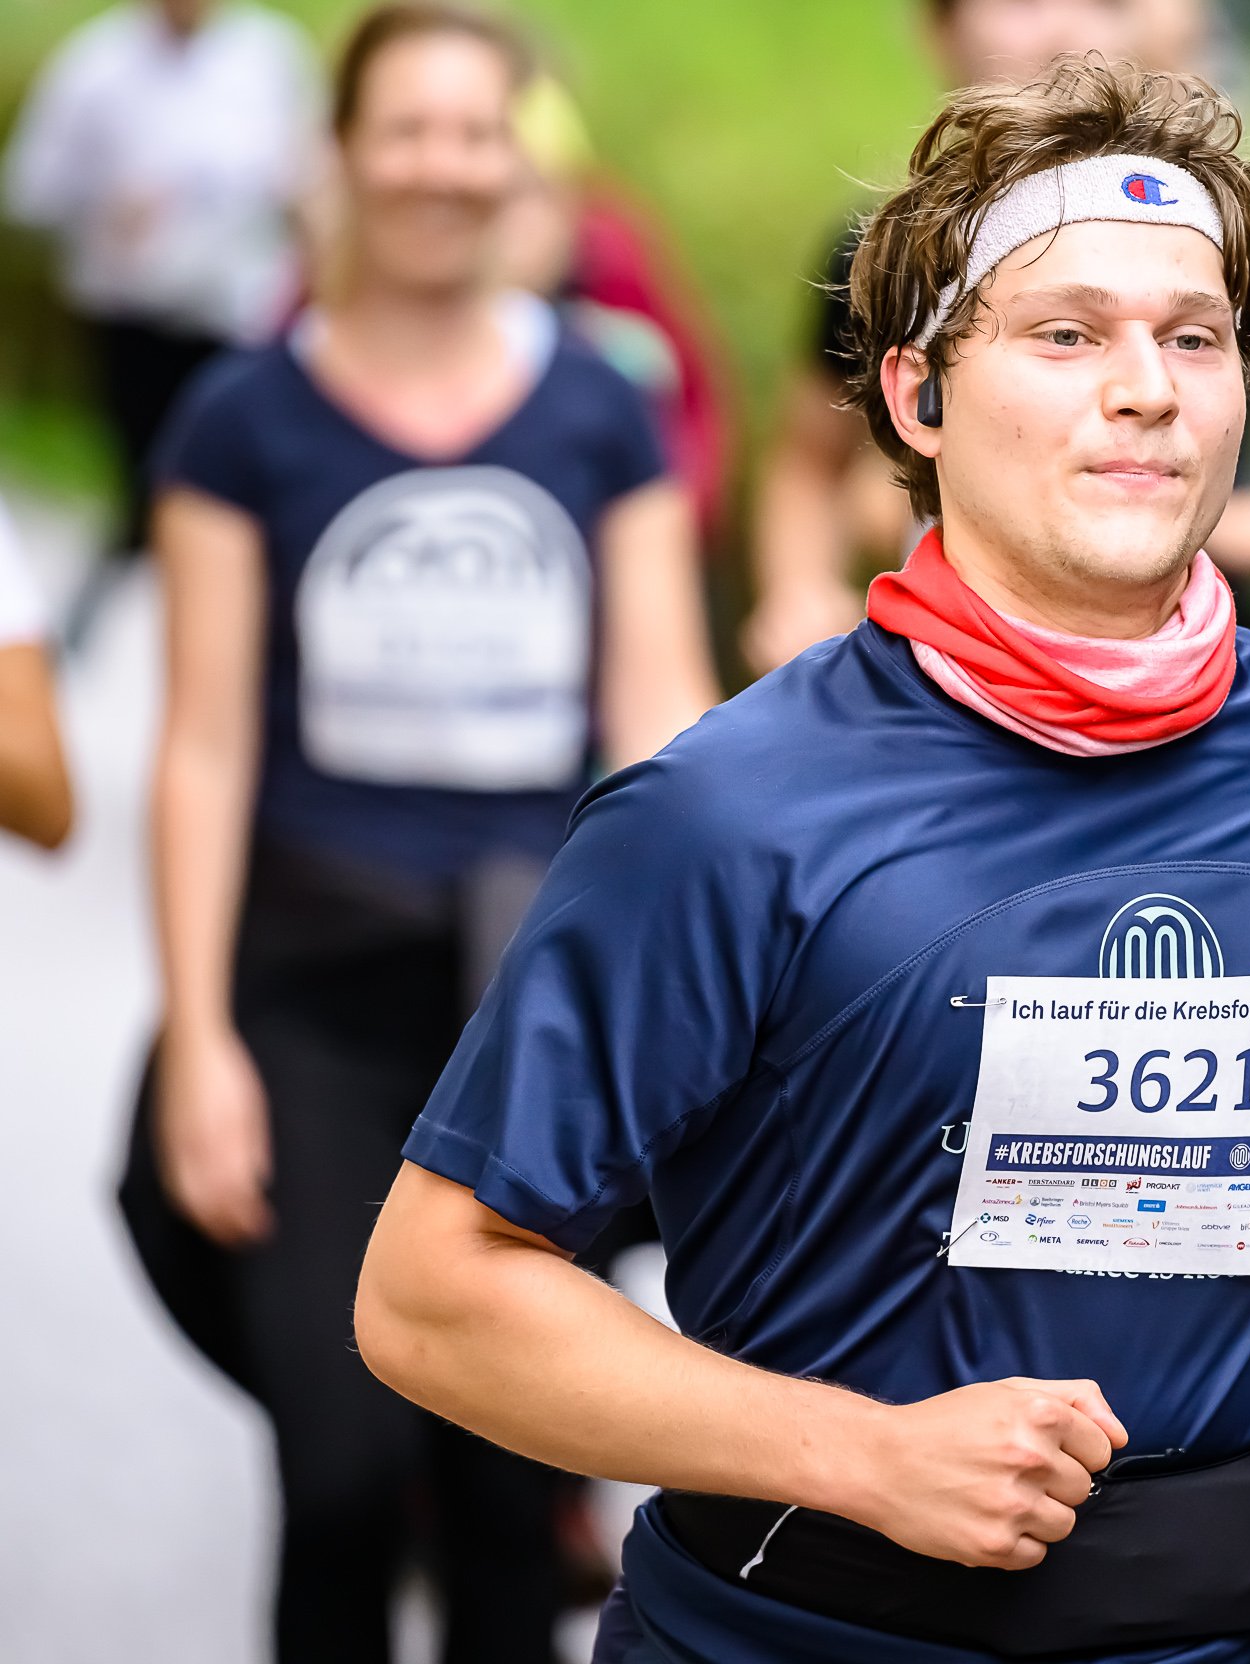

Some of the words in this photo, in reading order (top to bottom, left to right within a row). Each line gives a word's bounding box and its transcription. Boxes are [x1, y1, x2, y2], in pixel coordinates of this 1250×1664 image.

[1012, 999, 1044, 1019] Ich
[1051, 1000, 1094, 1020] lauf
[1098, 1000, 1130, 1020] für
[1135, 1001, 1167, 1020] die
[994, 1141, 1212, 1169] #KREBSFORSCHUNGSLAUF
[1036, 1217, 1056, 1227] Pfizer
[1040, 1236, 1061, 1244] META
[1076, 1238, 1106, 1246] SERVIER
